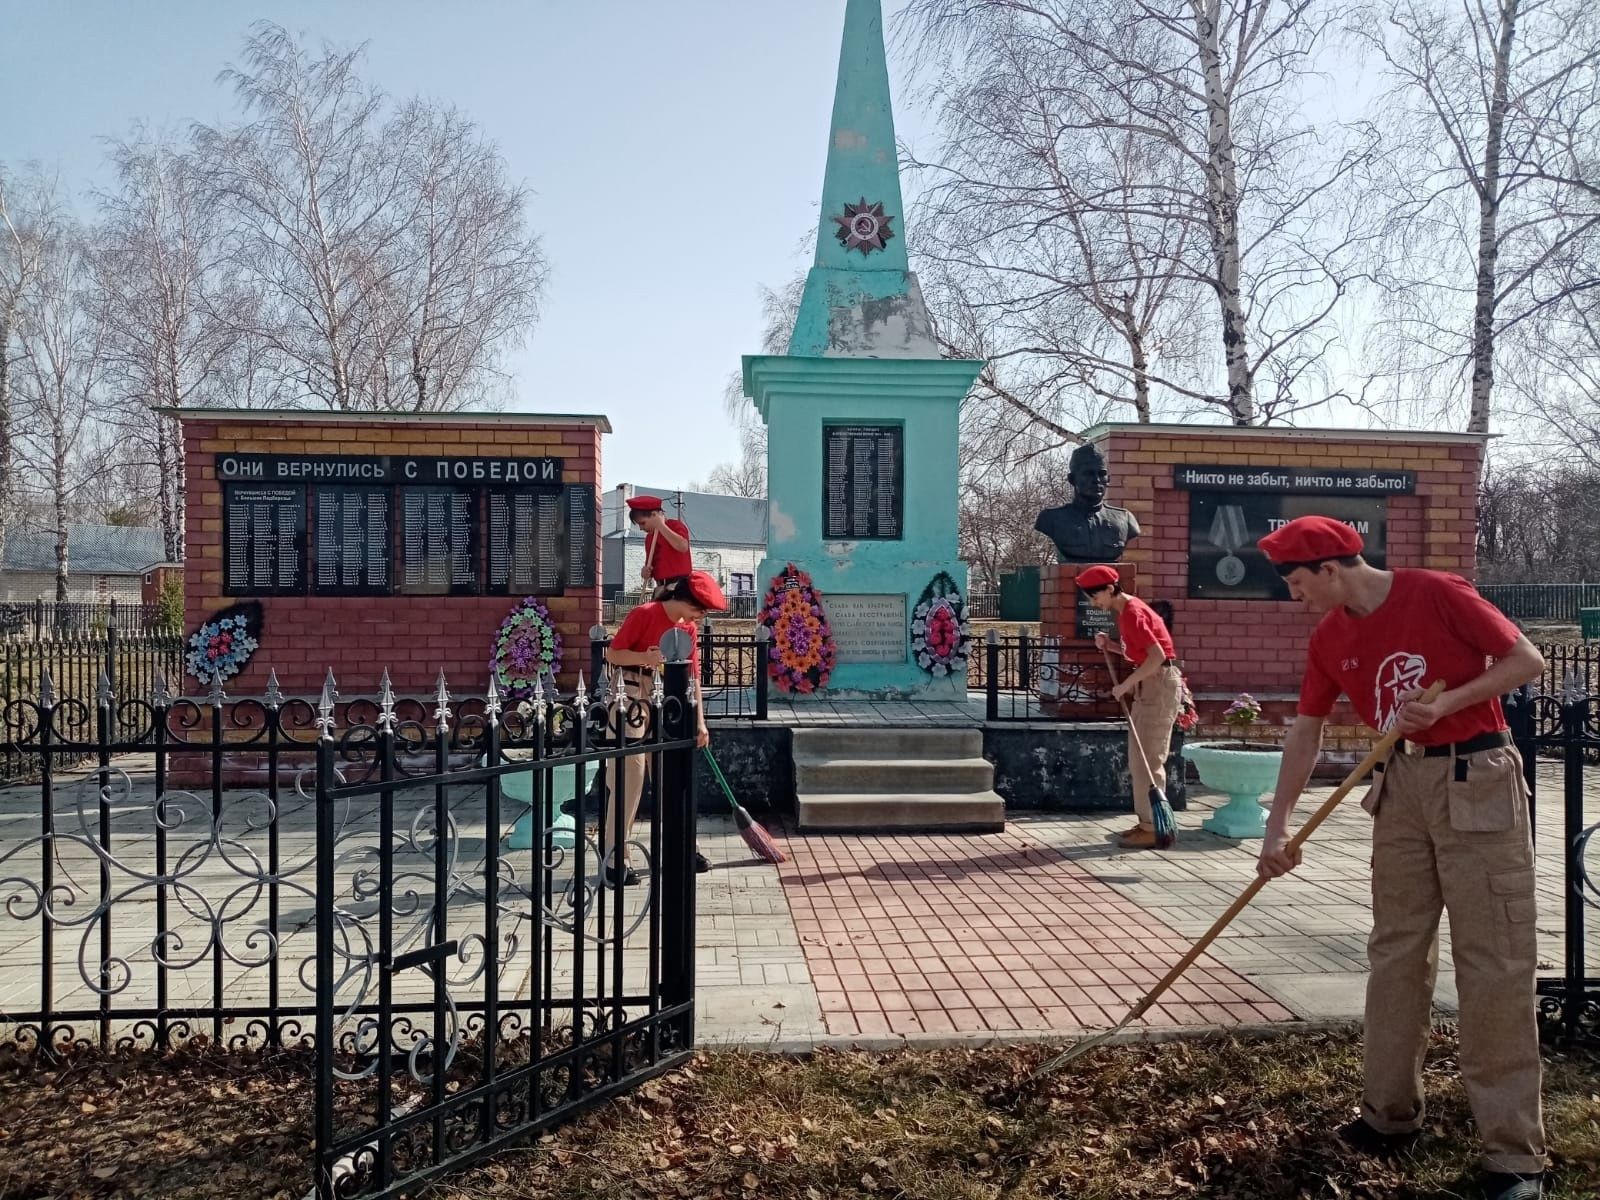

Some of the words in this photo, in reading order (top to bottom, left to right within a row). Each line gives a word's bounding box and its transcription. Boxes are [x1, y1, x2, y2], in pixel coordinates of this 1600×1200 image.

[222, 458, 264, 476] Они
[277, 462, 385, 478] ВЕРНУЛИСЬ
[404, 461, 418, 479] С
[436, 459, 554, 482] ПОБЕДОЙ
[1185, 470, 1225, 484] Никто
[1228, 473, 1244, 485] не
[1247, 472, 1290, 488] забыт,
[1295, 474, 1334, 487] ничто
[1336, 475, 1352, 488] не
[1355, 474, 1407, 489] забыто!
